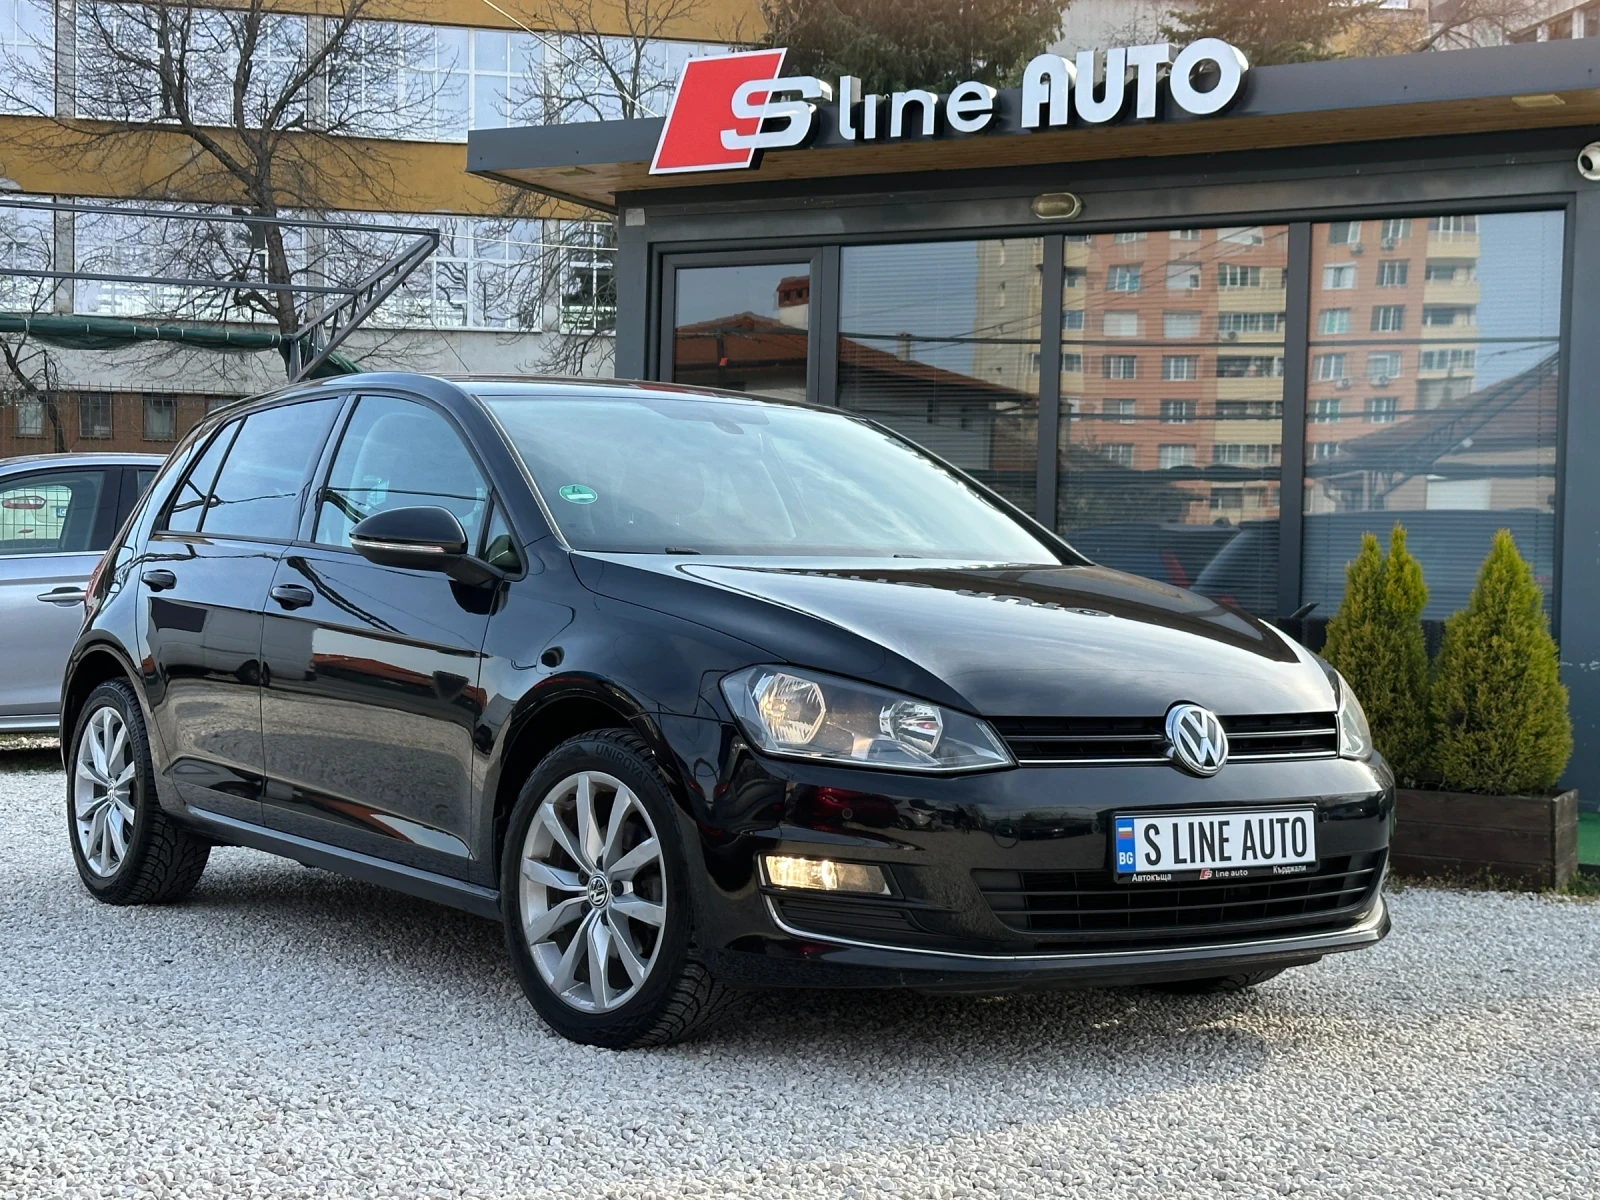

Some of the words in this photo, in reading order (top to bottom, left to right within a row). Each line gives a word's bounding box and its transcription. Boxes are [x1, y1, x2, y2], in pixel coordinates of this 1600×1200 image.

[1021, 37, 1249, 129] AUTO
[595, 744, 649, 785] UNIROYAL
[1143, 822, 1162, 866] S
[1171, 819, 1232, 865] LINE
[1241, 816, 1308, 861] AUTO
[1119, 851, 1134, 865] BG
[1131, 873, 1172, 883] Автокъща
[1230, 868, 1249, 877] auto
